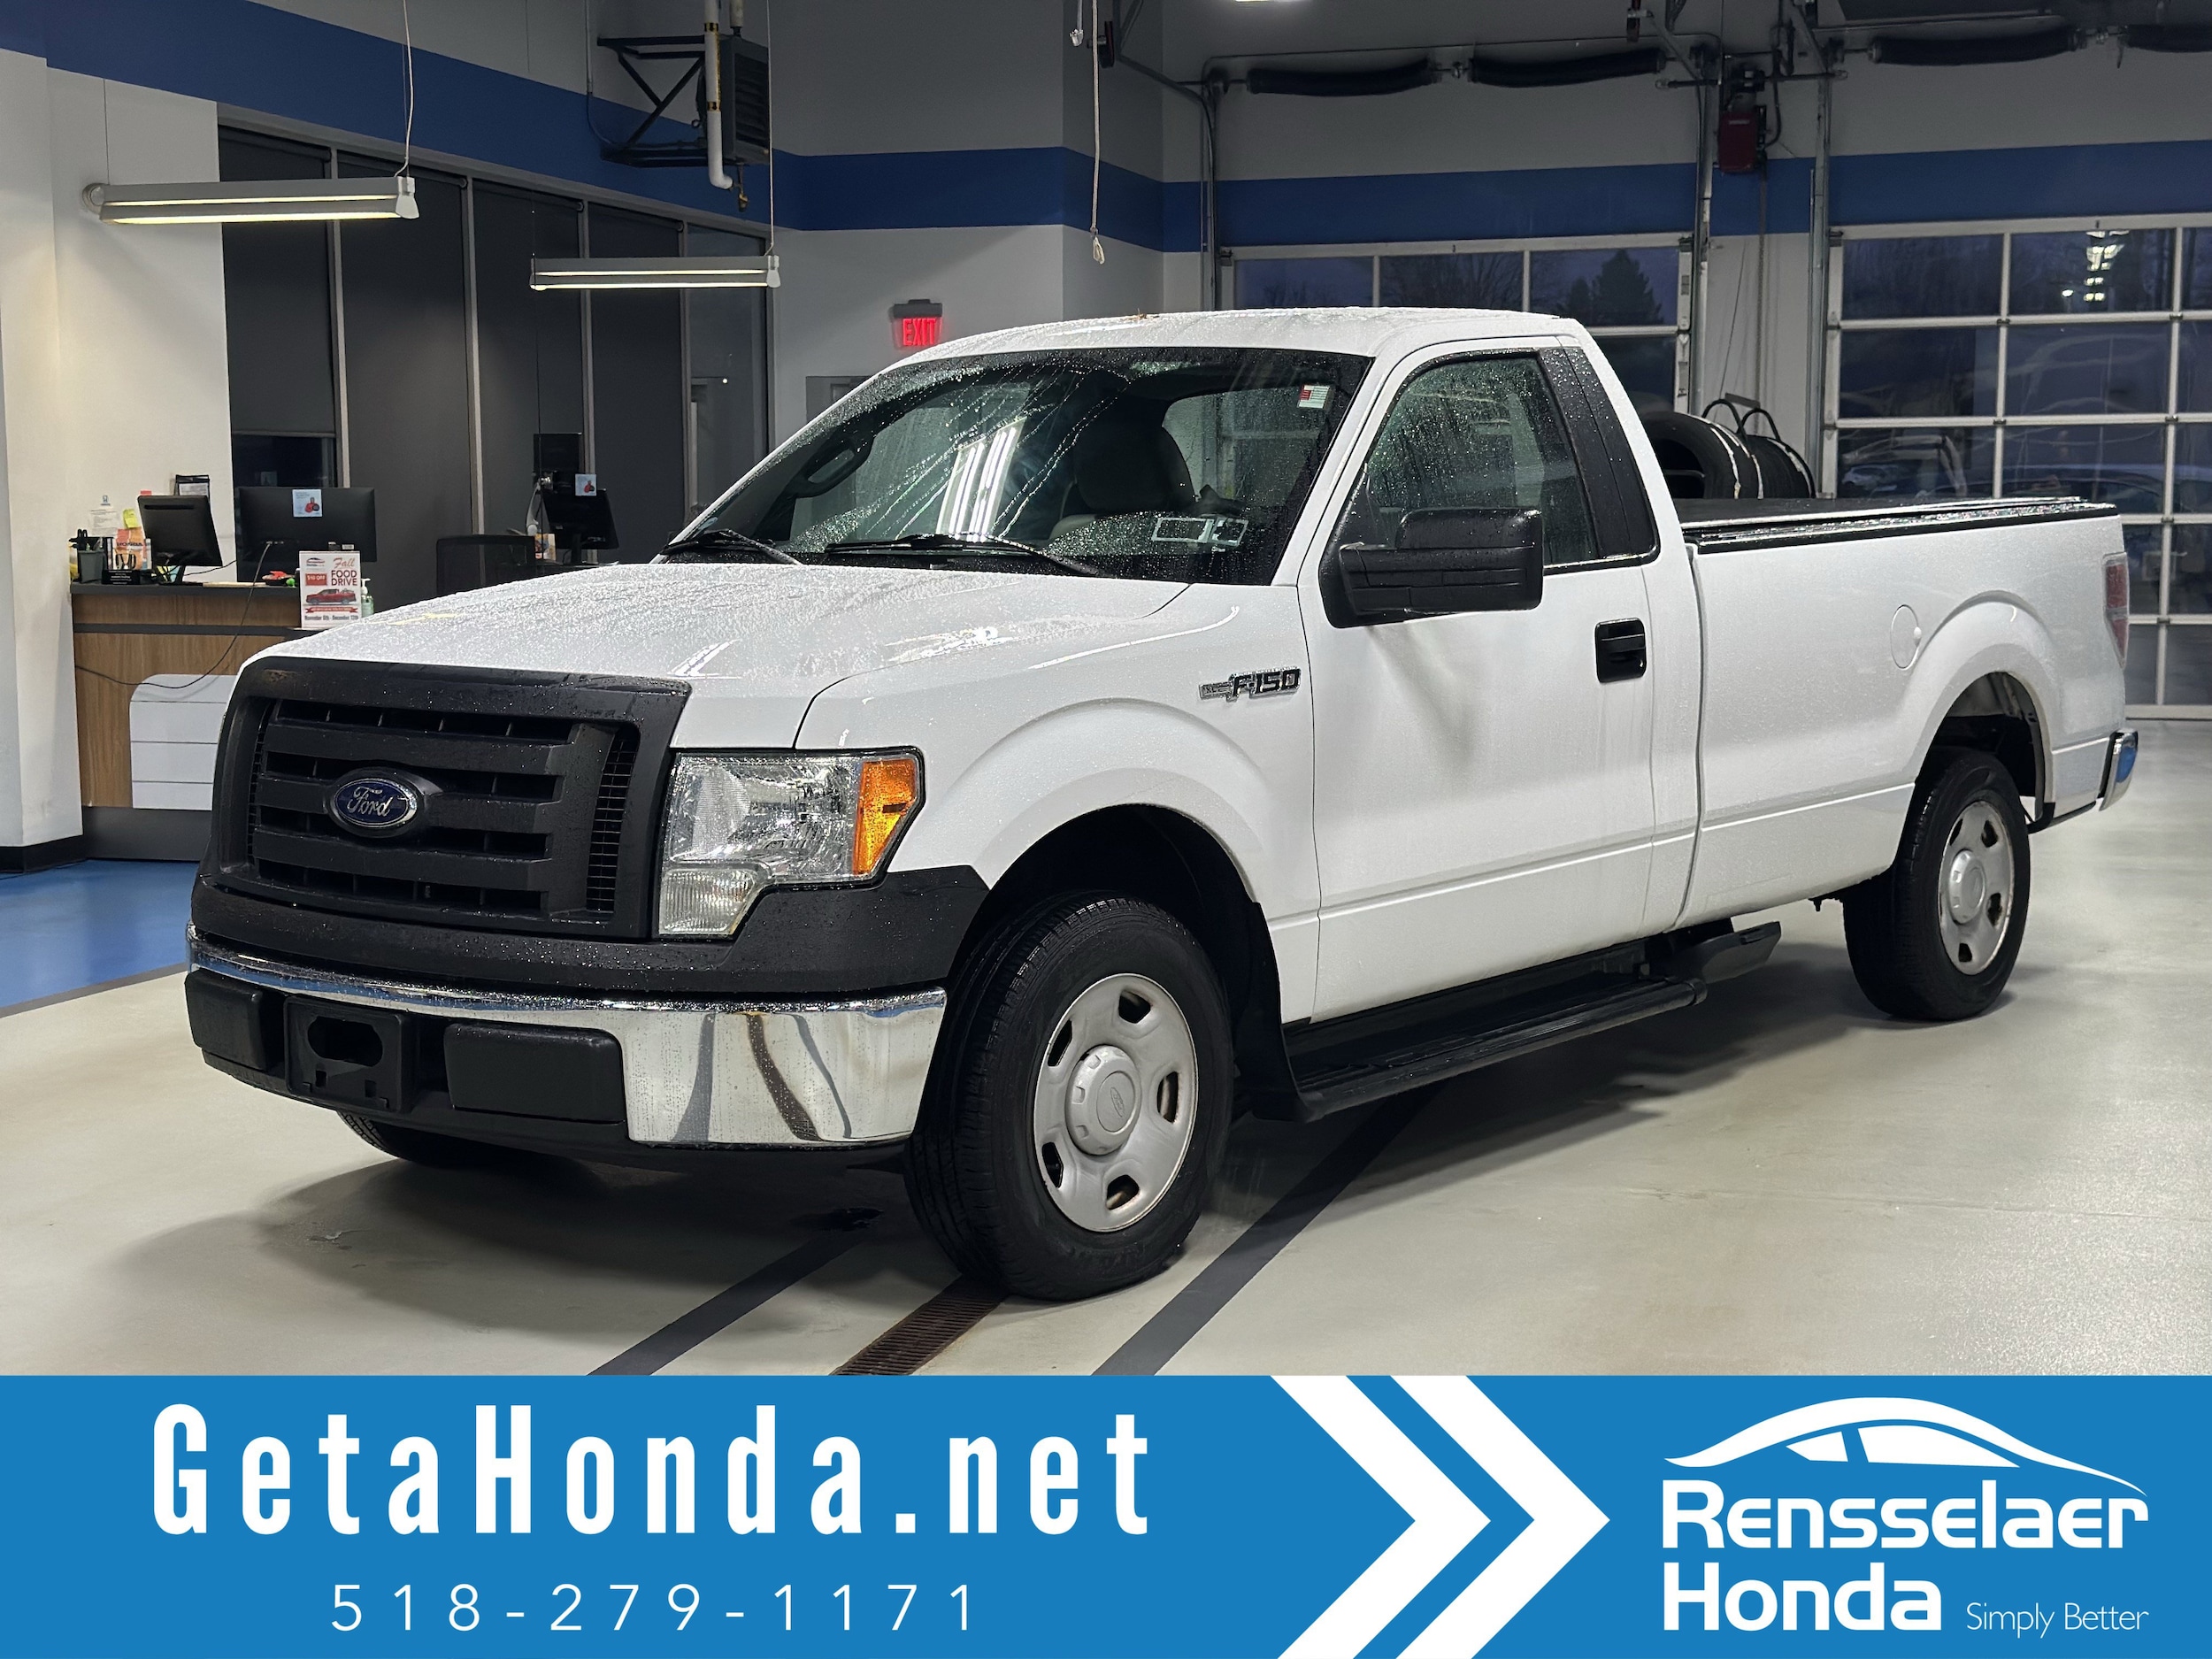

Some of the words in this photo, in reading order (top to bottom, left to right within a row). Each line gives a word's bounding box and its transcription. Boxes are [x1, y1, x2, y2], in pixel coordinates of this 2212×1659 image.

[902, 318, 937, 346] EXIT
[333, 557, 356, 569] Fall
[347, 786, 394, 817] Ford
